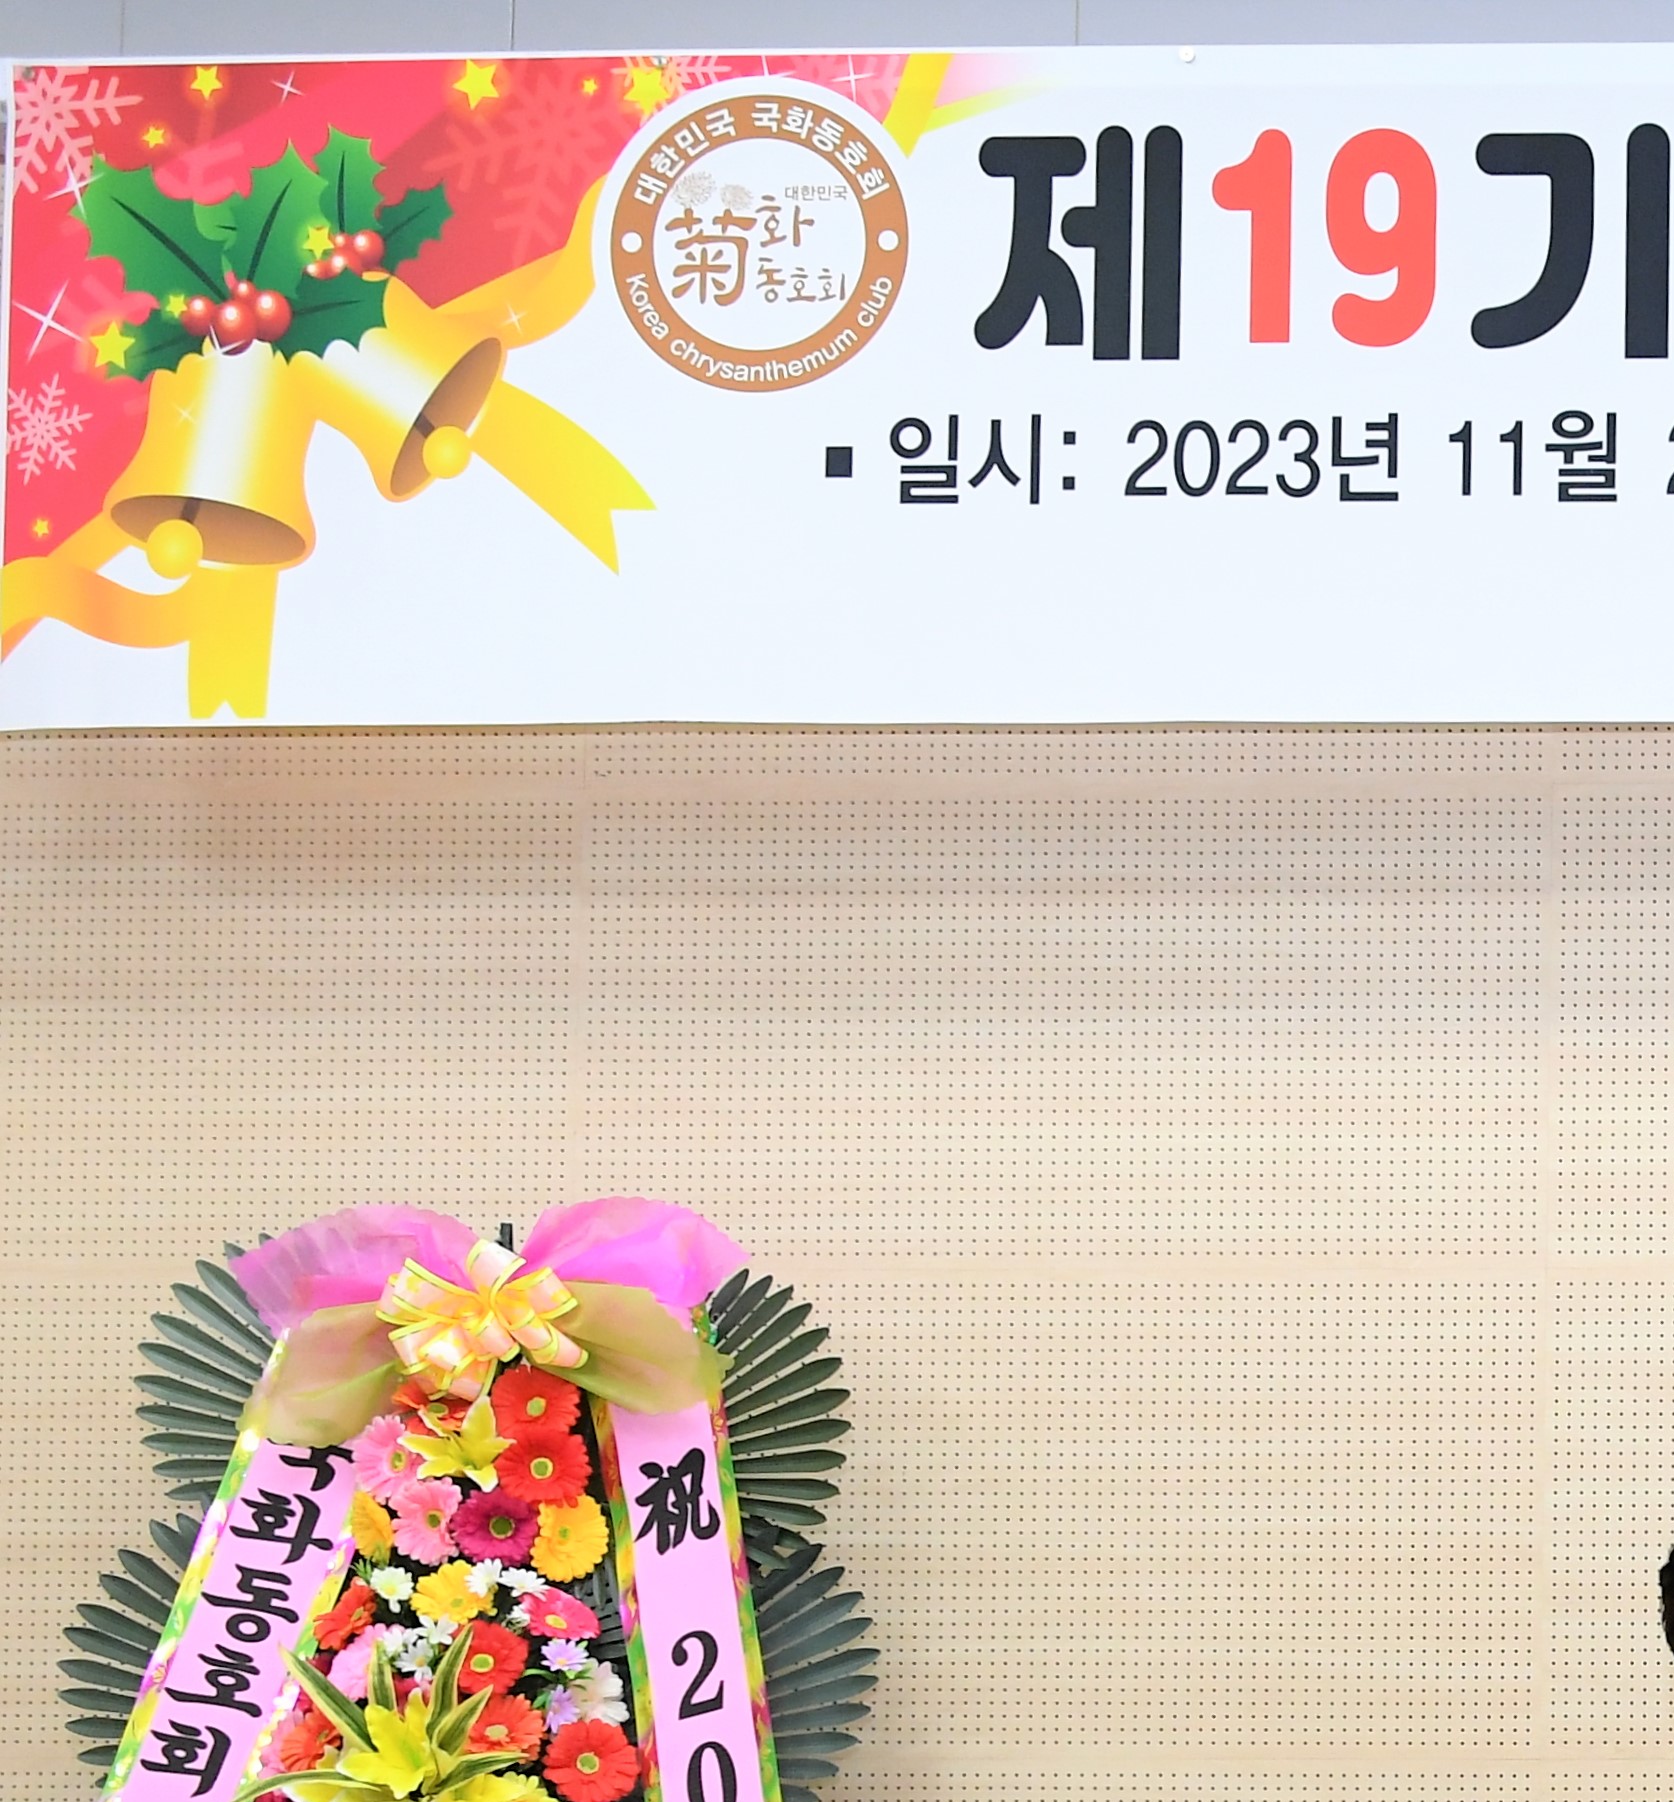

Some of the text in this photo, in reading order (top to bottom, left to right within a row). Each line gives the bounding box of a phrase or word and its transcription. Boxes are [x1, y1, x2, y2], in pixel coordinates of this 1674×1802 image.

[633, 101, 890, 205] 대한민국 국화동호회
[784, 184, 849, 201] 대한민국
[974, 121, 1671, 360] 제19기
[625, 273, 892, 382] Korea chrysanthemum club
[889, 412, 1077, 504] 일시:
[1124, 412, 1399, 501] 2023년
[1448, 410, 1618, 502] 11월
[635, 1447, 721, 1555] 祝
